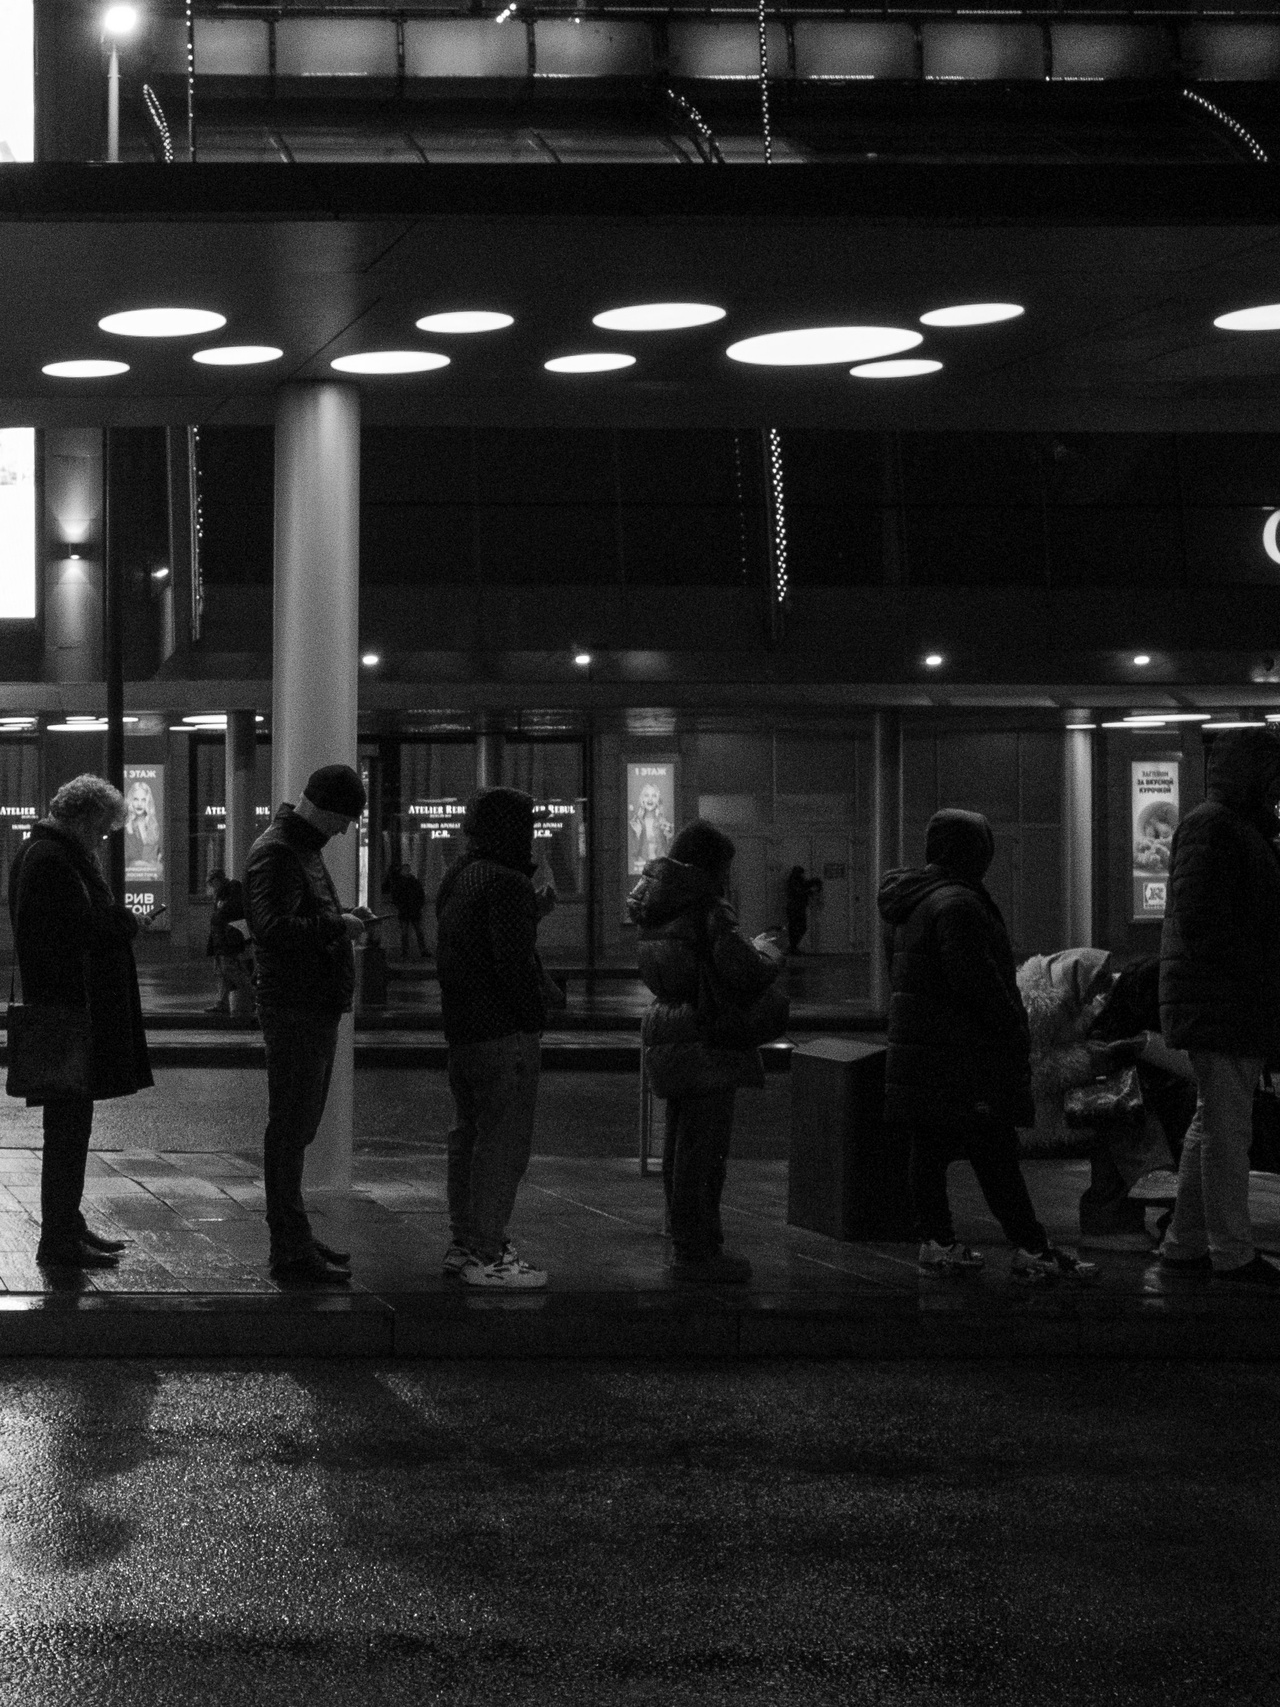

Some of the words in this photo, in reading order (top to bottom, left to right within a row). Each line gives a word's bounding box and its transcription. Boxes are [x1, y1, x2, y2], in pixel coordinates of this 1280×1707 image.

[129, 769, 157, 778] ЭТАЖ
[641, 767, 667, 776] ЭТАЖ
[205, 806, 227, 816] ATEL
[125, 893, 155, 904] РИВ
